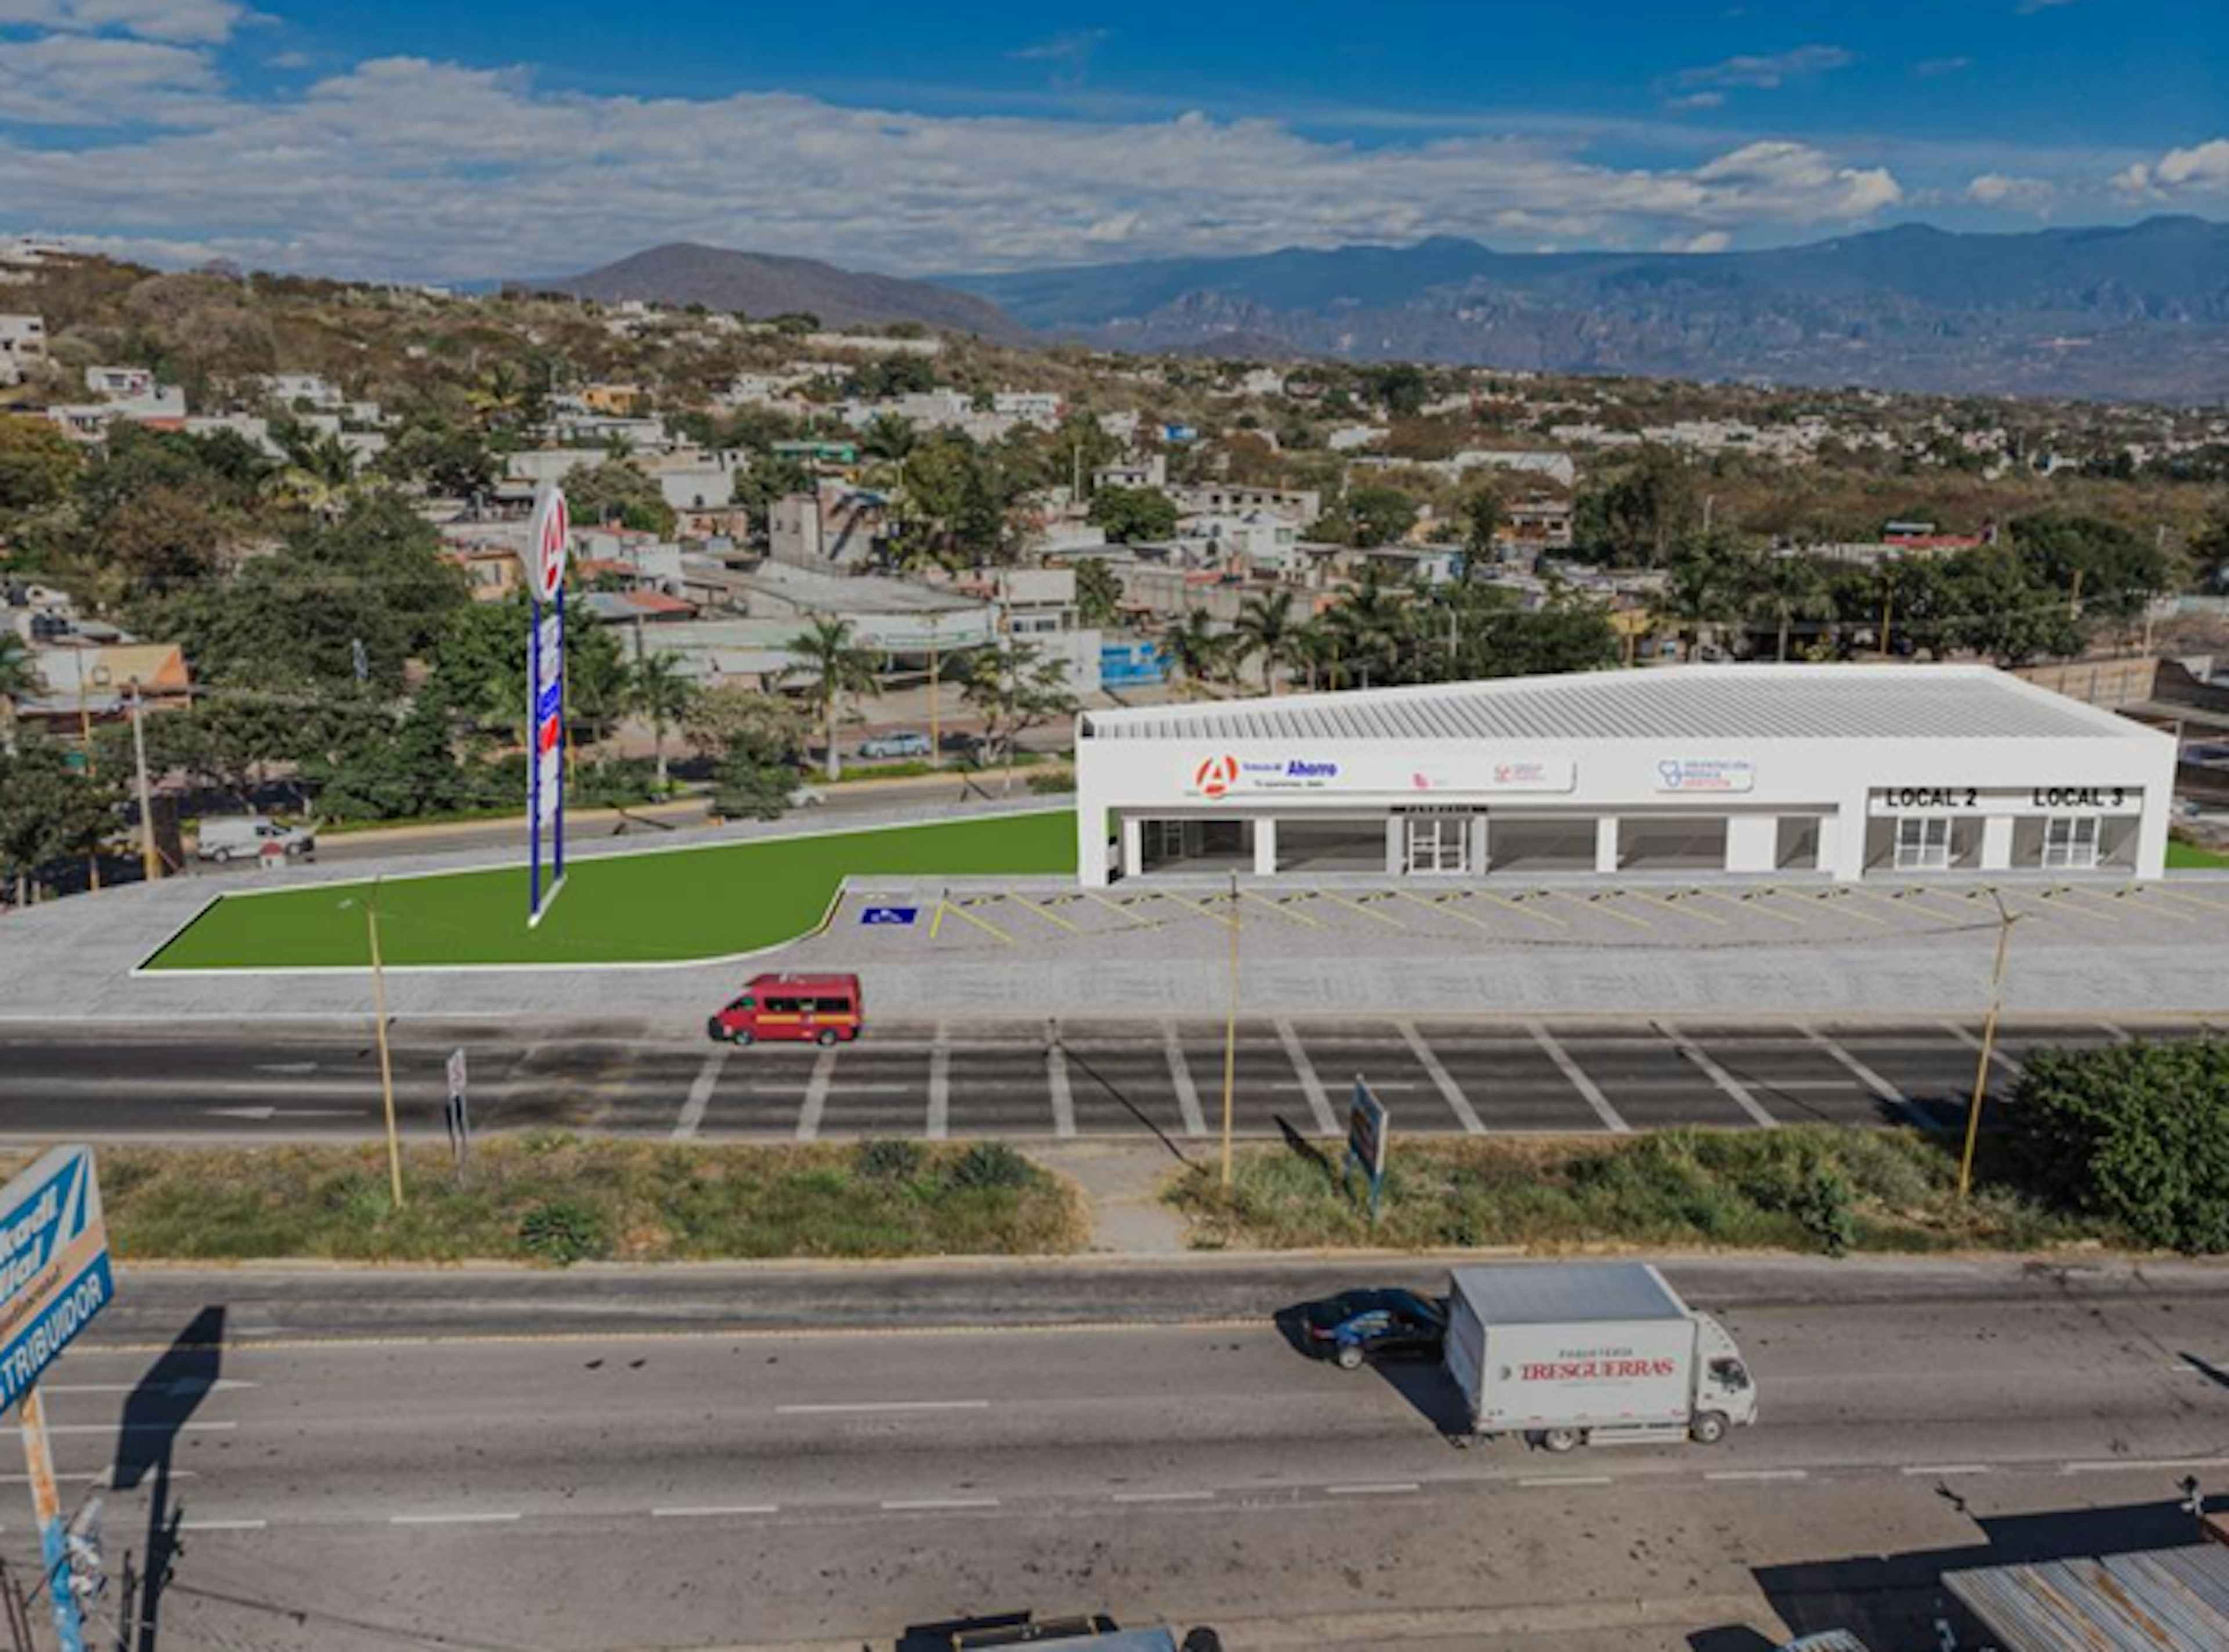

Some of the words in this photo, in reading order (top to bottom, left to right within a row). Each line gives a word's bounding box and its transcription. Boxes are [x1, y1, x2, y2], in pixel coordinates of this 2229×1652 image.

[1887, 787, 1957, 807] LOCAL
[1965, 787, 1977, 807] 2
[2033, 787, 2104, 807] LOCAL
[2112, 787, 2125, 807] 3
[1521, 1359, 1674, 1380] TRESGUERRAS
